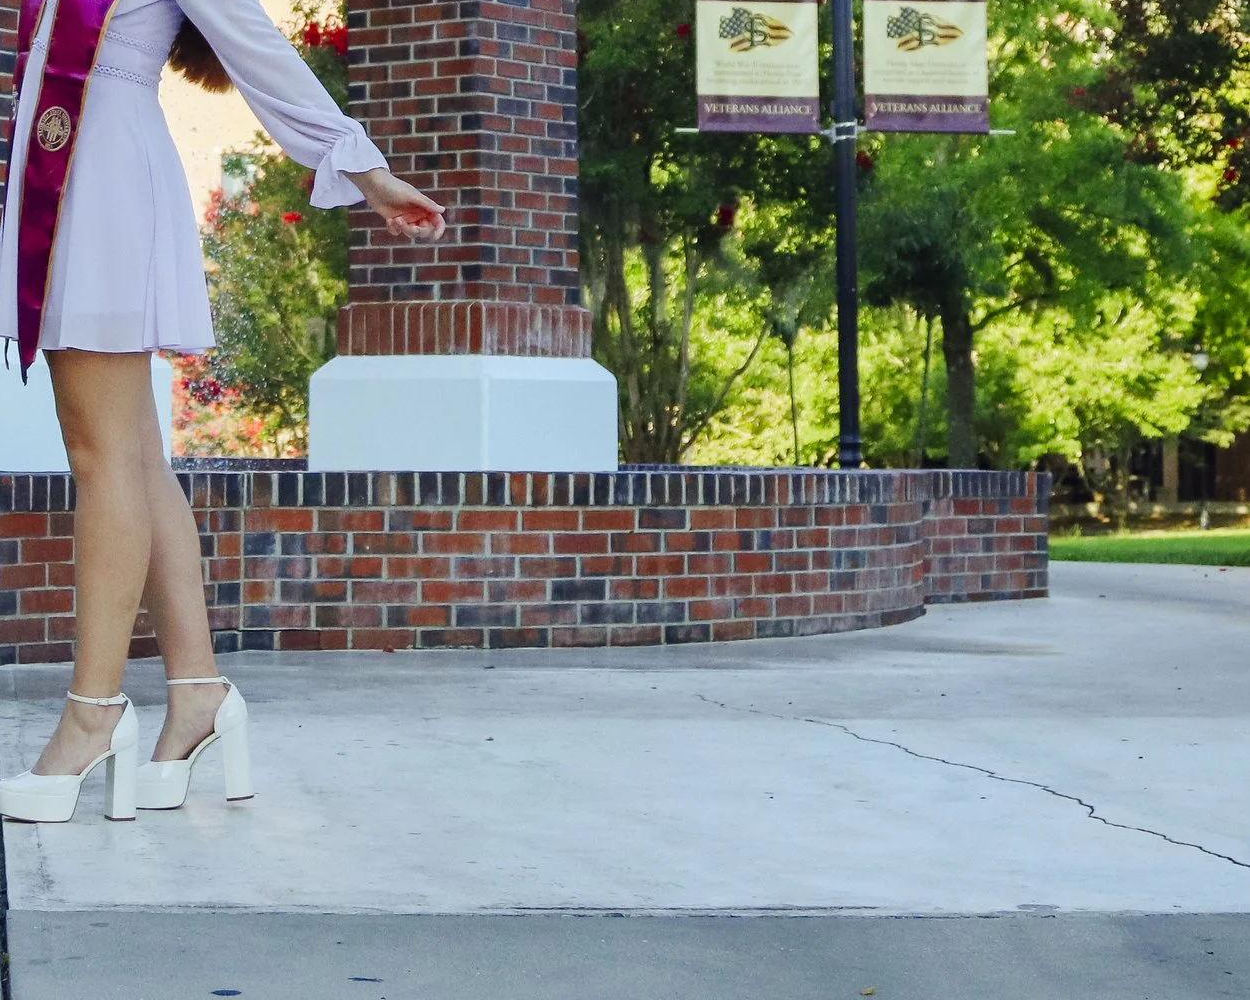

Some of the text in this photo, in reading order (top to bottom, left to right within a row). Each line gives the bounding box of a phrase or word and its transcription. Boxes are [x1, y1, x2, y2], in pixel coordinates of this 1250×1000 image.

[704, 103, 813, 115] VETERANS ALLIANCE
[871, 102, 983, 114] VETERANS ALLIANCE
